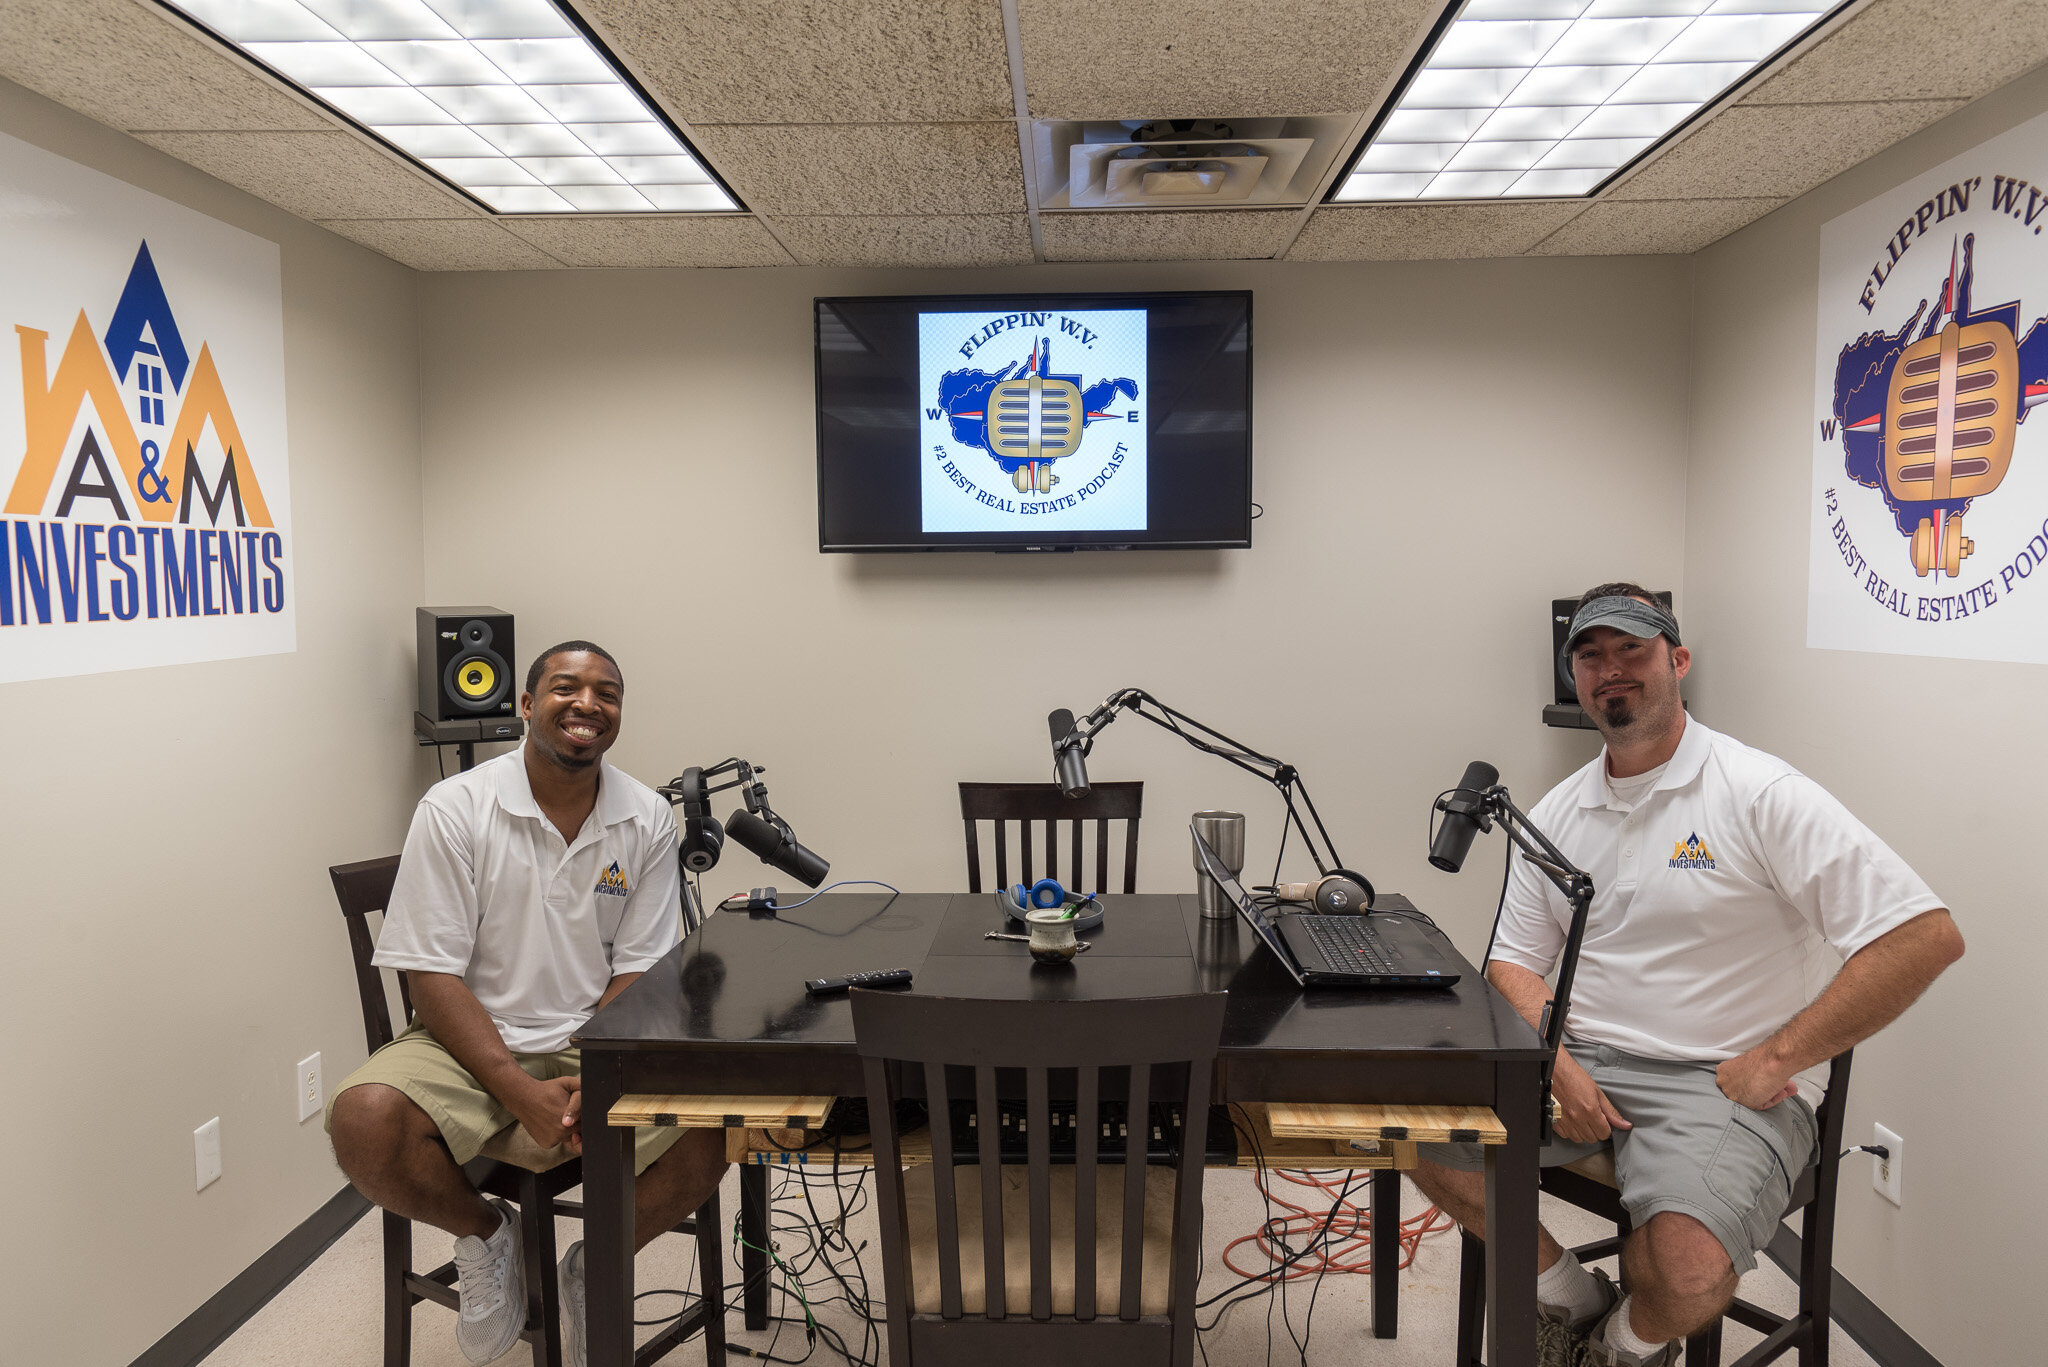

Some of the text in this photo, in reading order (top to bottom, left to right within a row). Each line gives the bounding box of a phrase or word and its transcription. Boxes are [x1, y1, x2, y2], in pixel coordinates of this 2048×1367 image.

[1991, 174, 2048, 236] W.V.
[1060, 315, 1098, 350] W.V.
[925, 408, 943, 421] W
[1127, 410, 1139, 423] E
[1820, 418, 1838, 442] W
[933, 441, 1129, 515] #2 BEST REAL ESTATE PODCAST
[1824, 487, 1839, 516] #2
[1831, 516, 1867, 579] BEST
[0, 519, 285, 627] INVESTMENTS
[1864, 569, 1911, 618] REAL
[1916, 578, 1998, 623] ESTATE
[1668, 859, 1715, 869] INVESTMENTS
